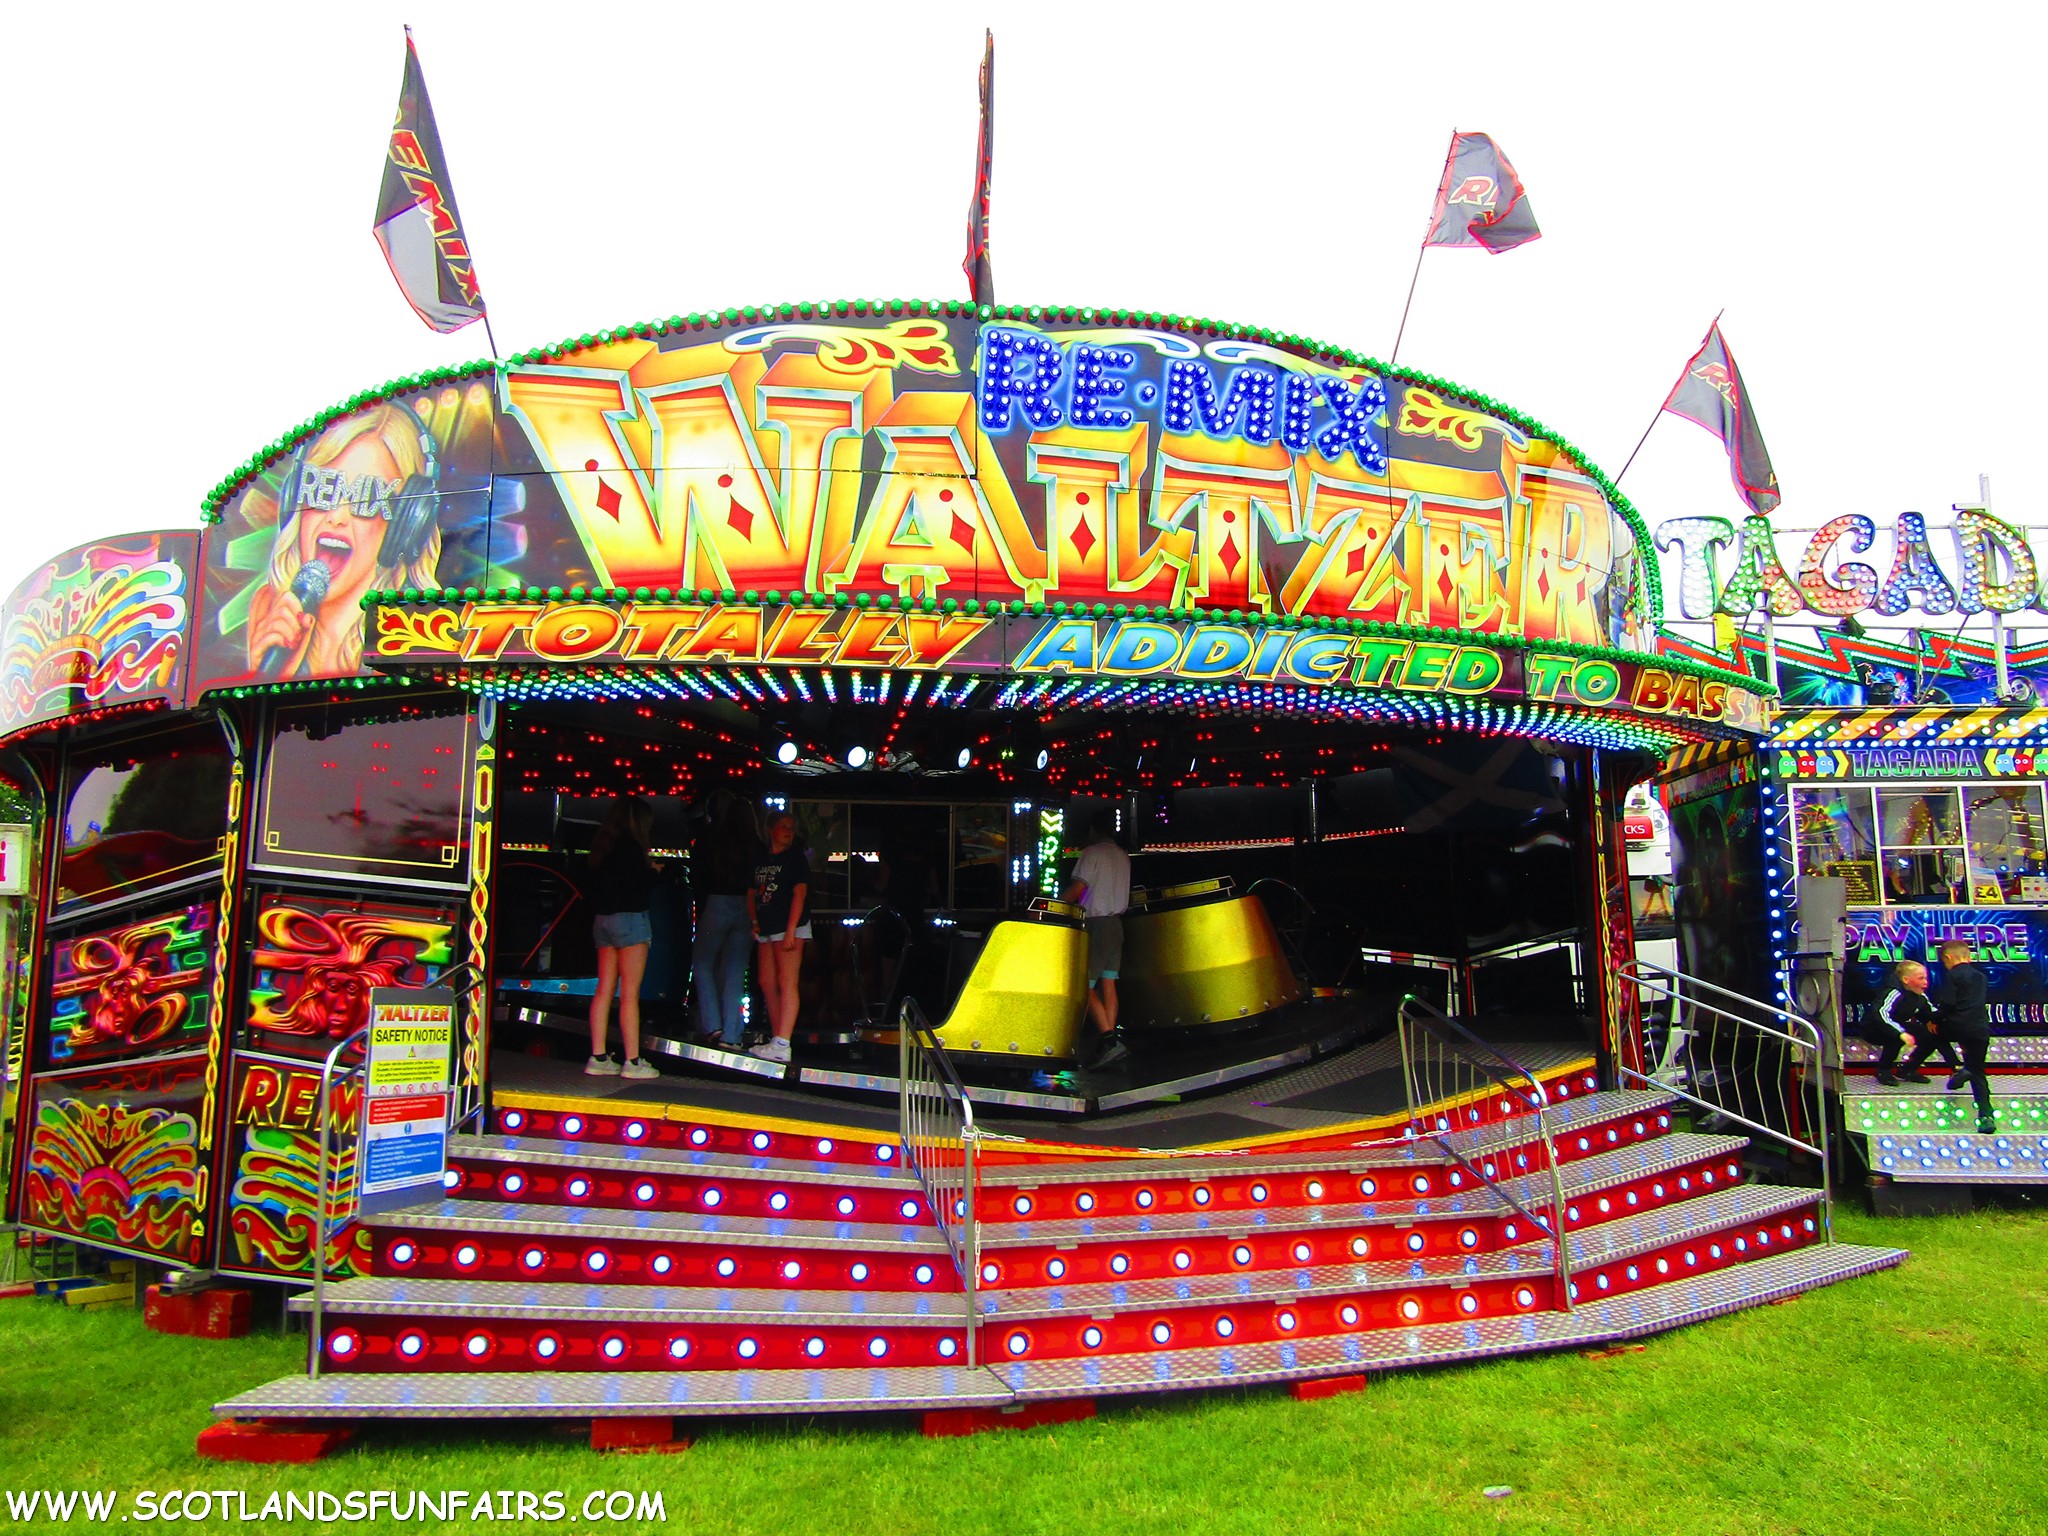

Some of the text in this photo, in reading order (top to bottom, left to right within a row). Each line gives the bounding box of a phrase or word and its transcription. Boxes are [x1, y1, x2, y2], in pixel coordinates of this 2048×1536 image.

[297, 463, 403, 521] REMIX
[497, 350, 1615, 641] WALTZER
[1655, 511, 2048, 620] TAGAD
[461, 602, 1747, 728] TOTALLY ADDICTED TO BASS
[1847, 749, 1983, 777] TAGADA
[1974, 886, 1998, 899] £4
[1924, 924, 2031, 963] HERE
[377, 1005, 449, 1021] WALTZER
[376, 1029, 448, 1042] SAFETY NOTICE
